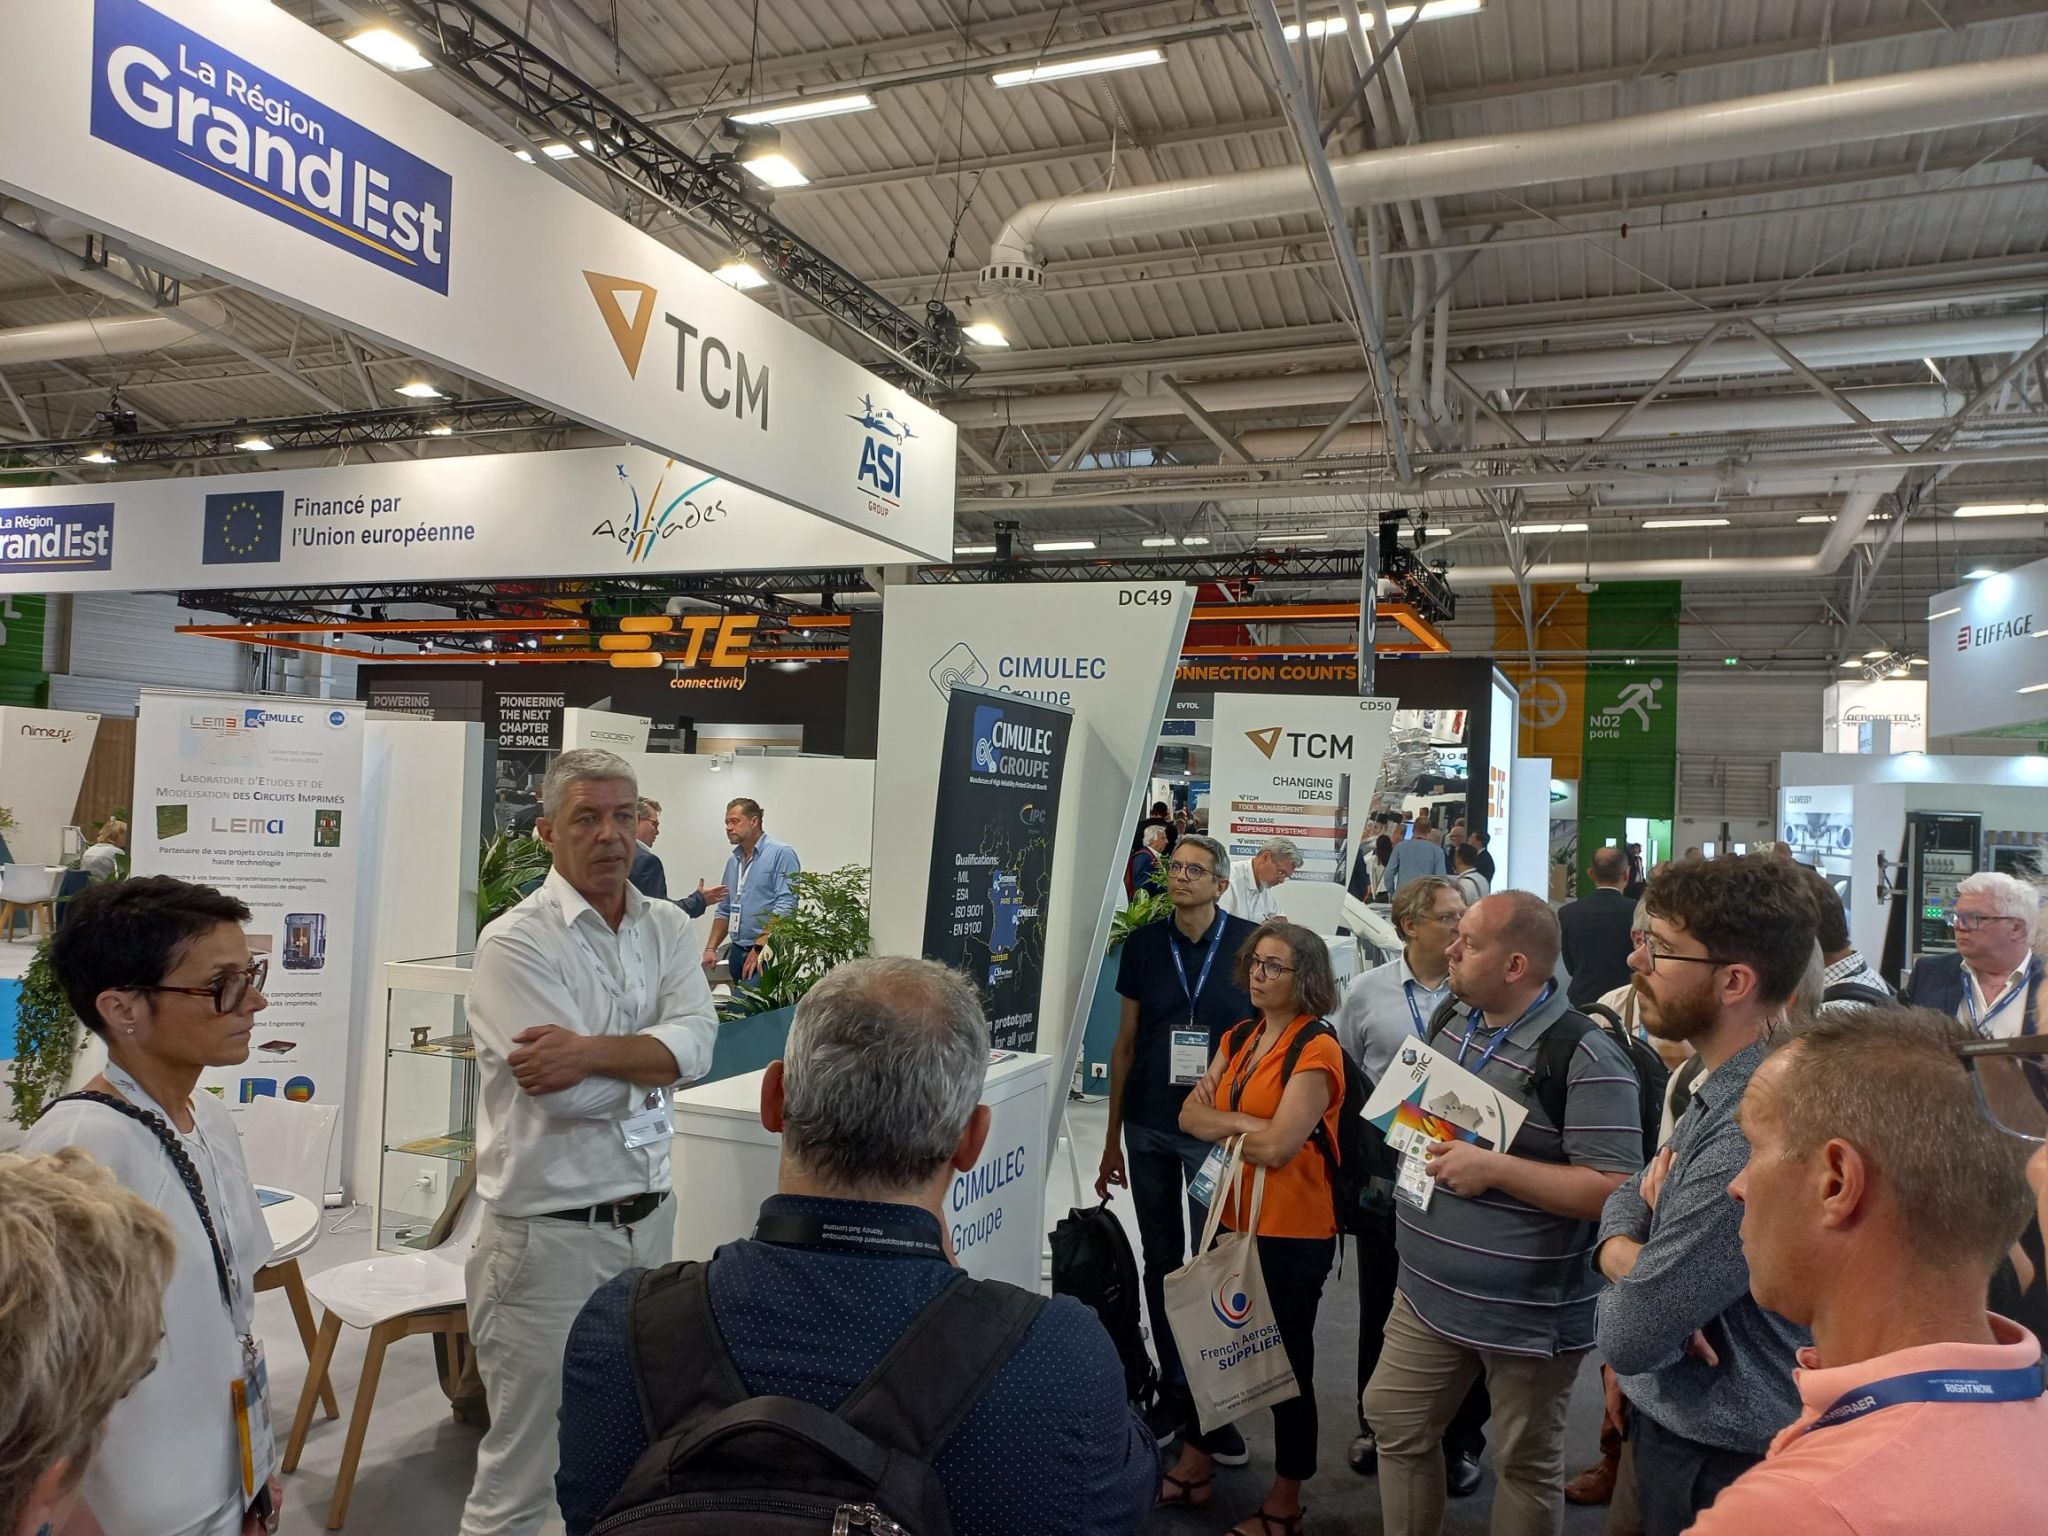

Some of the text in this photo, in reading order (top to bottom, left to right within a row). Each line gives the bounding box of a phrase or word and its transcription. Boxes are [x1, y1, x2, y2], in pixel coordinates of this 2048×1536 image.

[179, 43, 325, 145] La Région
[107, 44, 443, 265] Grand Est
[664, 311, 770, 432] TCM
[857, 435, 902, 498] ASI
[293, 493, 402, 518] Financé par
[867, 500, 890, 518] GROUP
[0, 514, 54, 530] La Région
[360, 520, 475, 547] européenne
[0, 523, 109, 560] rand Est
[1118, 589, 1173, 606] DC49
[1975, 614, 2033, 647] EIFFAGE
[681, 615, 761, 668] TE
[998, 656, 1107, 680] CIMULEC
[1174, 665, 1358, 681] ONNECTION COUNTS
[670, 676, 746, 691] connectivity
[373, 695, 430, 707] POWERING
[499, 696, 565, 708] PIONEERING
[1176, 702, 1201, 710] EVTOL
[1359, 701, 1392, 711] CD50
[258, 713, 304, 724] CIMULEC
[499, 709, 552, 721] THE NEXT
[499, 722, 549, 734] CHAPTER
[1589, 729, 1620, 741] porte
[499, 735, 550, 747] OF SPACE
[992, 721, 1053, 755] CIMULEC
[1286, 732, 1354, 760] TCM
[999, 755, 1050, 779] GROUPE
[180, 773, 245, 787] LABORATOIRE
[297, 780, 308, 788] ET
[310, 780, 324, 789] DE
[1272, 776, 1334, 789] CHANGING
[232, 791, 250, 800] DES
[253, 791, 296, 803] CIRCUITS
[298, 793, 345, 804] IMPRIMÉS
[1298, 789, 1333, 801] IDEAS
[1029, 807, 1046, 823] IPC
[1256, 804, 1305, 813] MANAGEMENT
[1236, 825, 1308, 836] DISPENSER SYSTEMS
[158, 846, 200, 855] Partenaire
[201, 847, 213, 855] de
[228, 848, 256, 860] projets
[256, 849, 285, 857] circuits
[286, 850, 321, 860] imprimés
[1236, 847, 1254, 855] TOOL
[212, 858, 282, 868] haute technologie
[955, 853, 1000, 866] Qualifications:
[957, 871, 970, 883] MIL
[956, 888, 969, 901] ESA
[954, 904, 984, 919] ISO 9001
[953, 921, 982, 936] EN 9100
[270, 991, 322, 999] comportement
[994, 1013, 1033, 1033] prototype
[994, 1031, 1035, 1049] for all your
[952, 1145, 1025, 1213] CIMULEC
[821, 1232, 864, 1243] économique
[848, 1226, 861, 1234] Sud
[861, 1227, 883, 1236] Nancy
[951, 1206, 1003, 1257] Groupe
[864, 1236, 915, 1248] développement
[1199, 1323, 1281, 1361] French Aerosp
[1218, 1334, 1282, 1371] SUPPLIER
[1822, 1395, 1877, 1423] MBRAER
